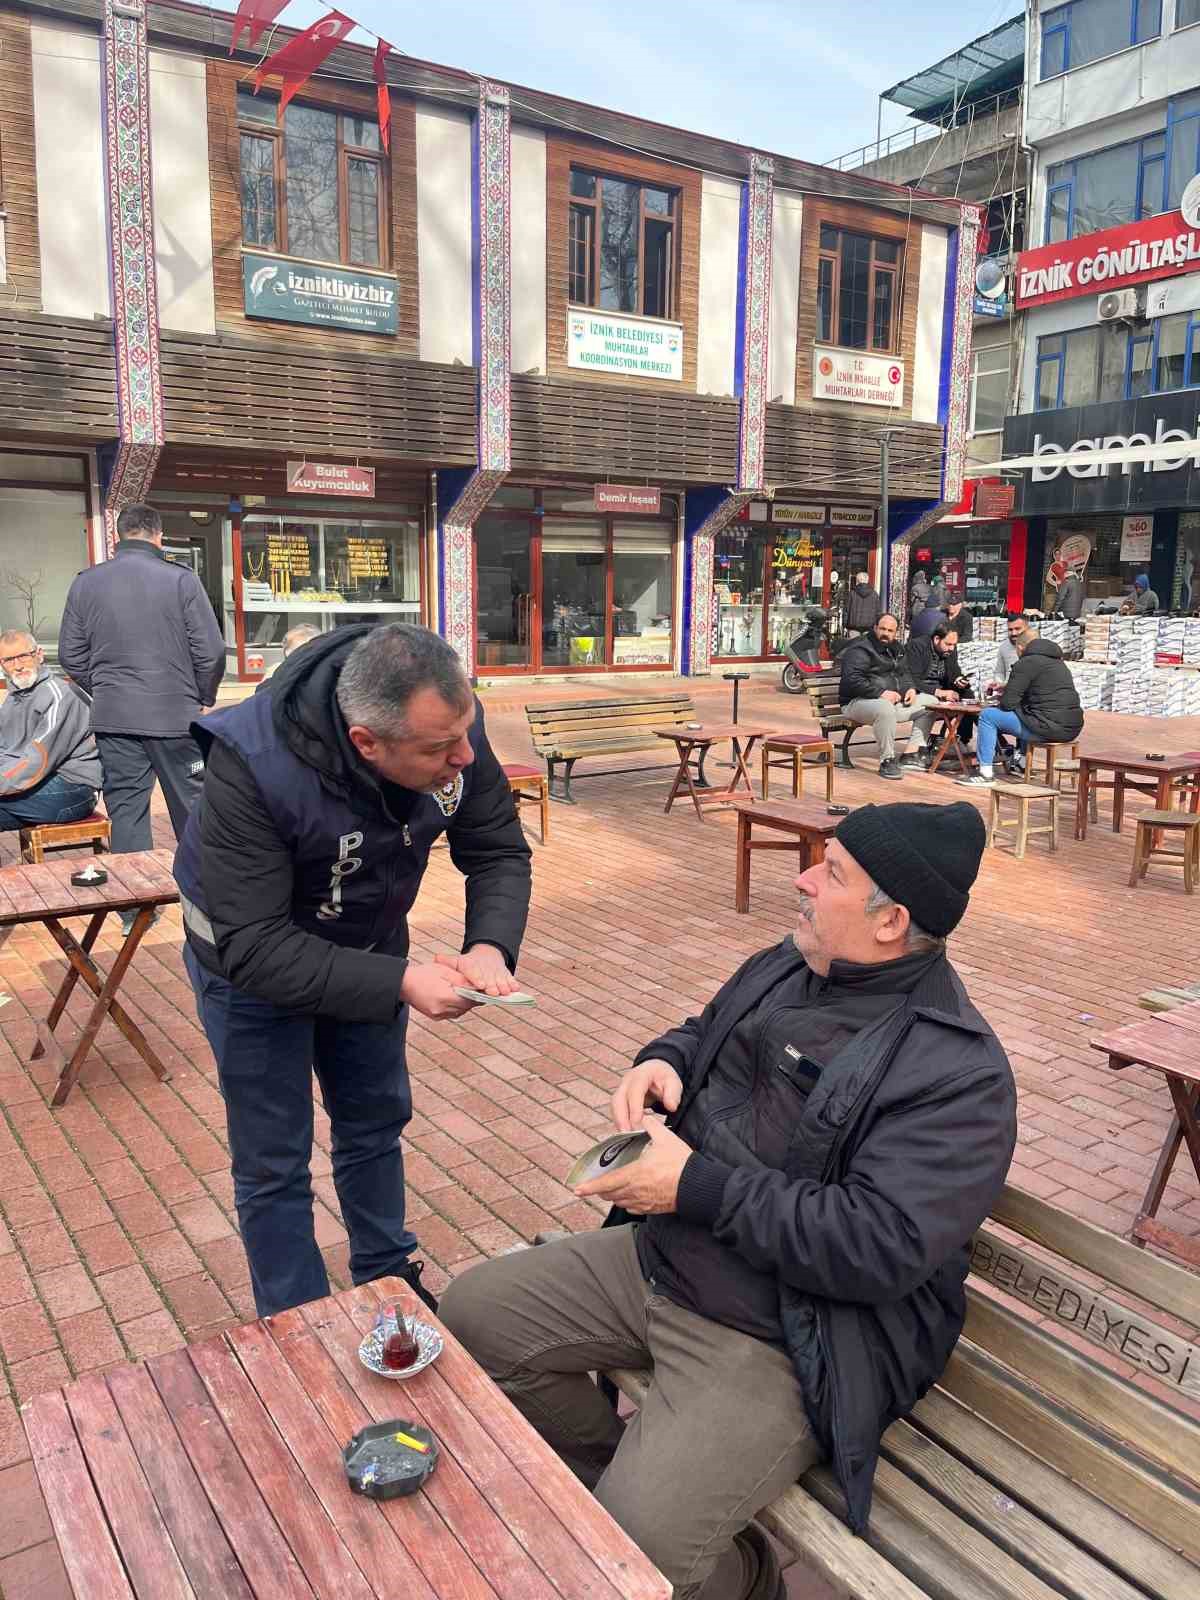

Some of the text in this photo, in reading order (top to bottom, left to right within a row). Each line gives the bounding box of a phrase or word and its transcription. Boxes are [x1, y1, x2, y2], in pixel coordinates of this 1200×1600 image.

[1019, 259, 1073, 298] İZNİK
[590, 321, 663, 345] İZNİK BELEDİYESİ
[604, 341, 649, 356] MUHTARLAR
[316, 466, 349, 479] Bulut
[599, 492, 627, 503] Demir
[970, 1240, 1193, 1385] BELEDİYESİ
